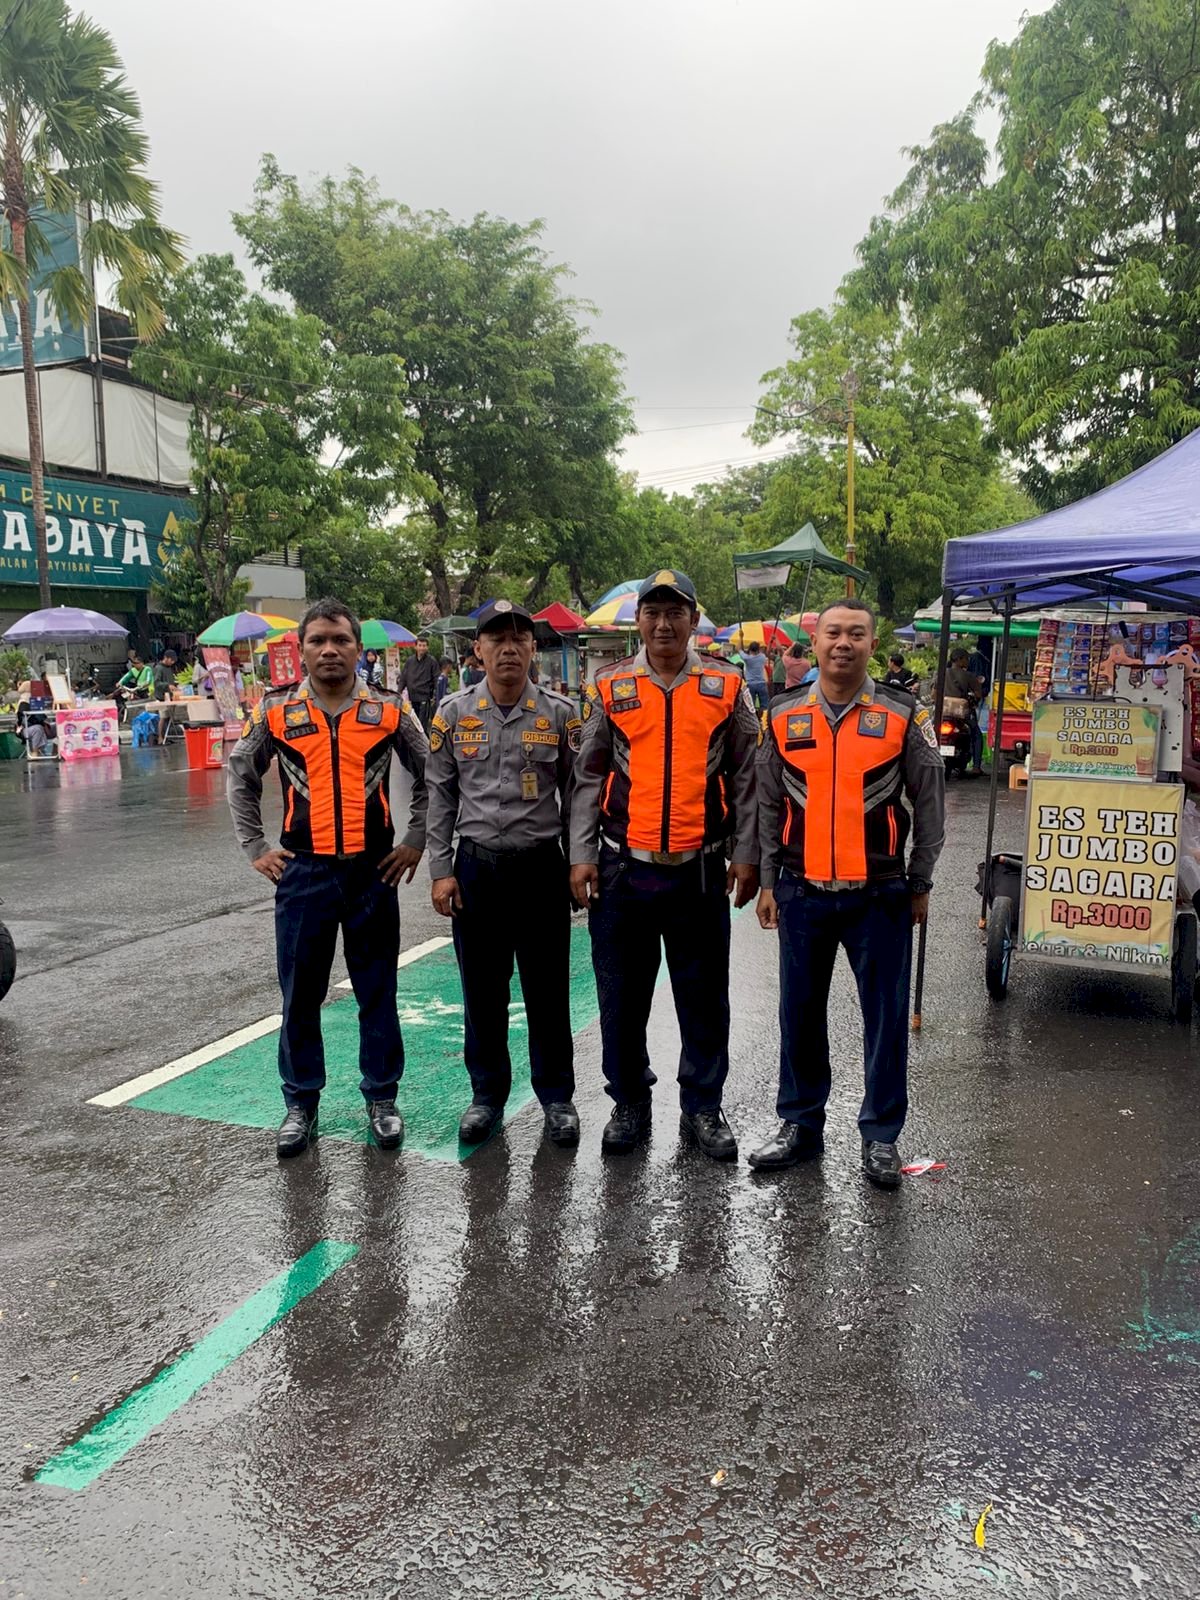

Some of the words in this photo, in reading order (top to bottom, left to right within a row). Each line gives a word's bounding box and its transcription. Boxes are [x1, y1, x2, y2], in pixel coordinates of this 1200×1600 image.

[35, 560, 91, 573] TAYYIBAN
[1063, 707, 1087, 717] ES
[1092, 708, 1130, 719] TEH
[1062, 717, 1130, 730] JUMBO
[525, 733, 558, 744] DISHUB
[1057, 730, 1133, 745] SAGARA
[1038, 805, 1085, 831] ES
[1098, 808, 1177, 837] TEH
[1036, 833, 1176, 866] JUMBO
[1026, 864, 1175, 902] SAGARA
[1051, 899, 1151, 930] Rp.3000
[1084, 943, 1098, 958] &
